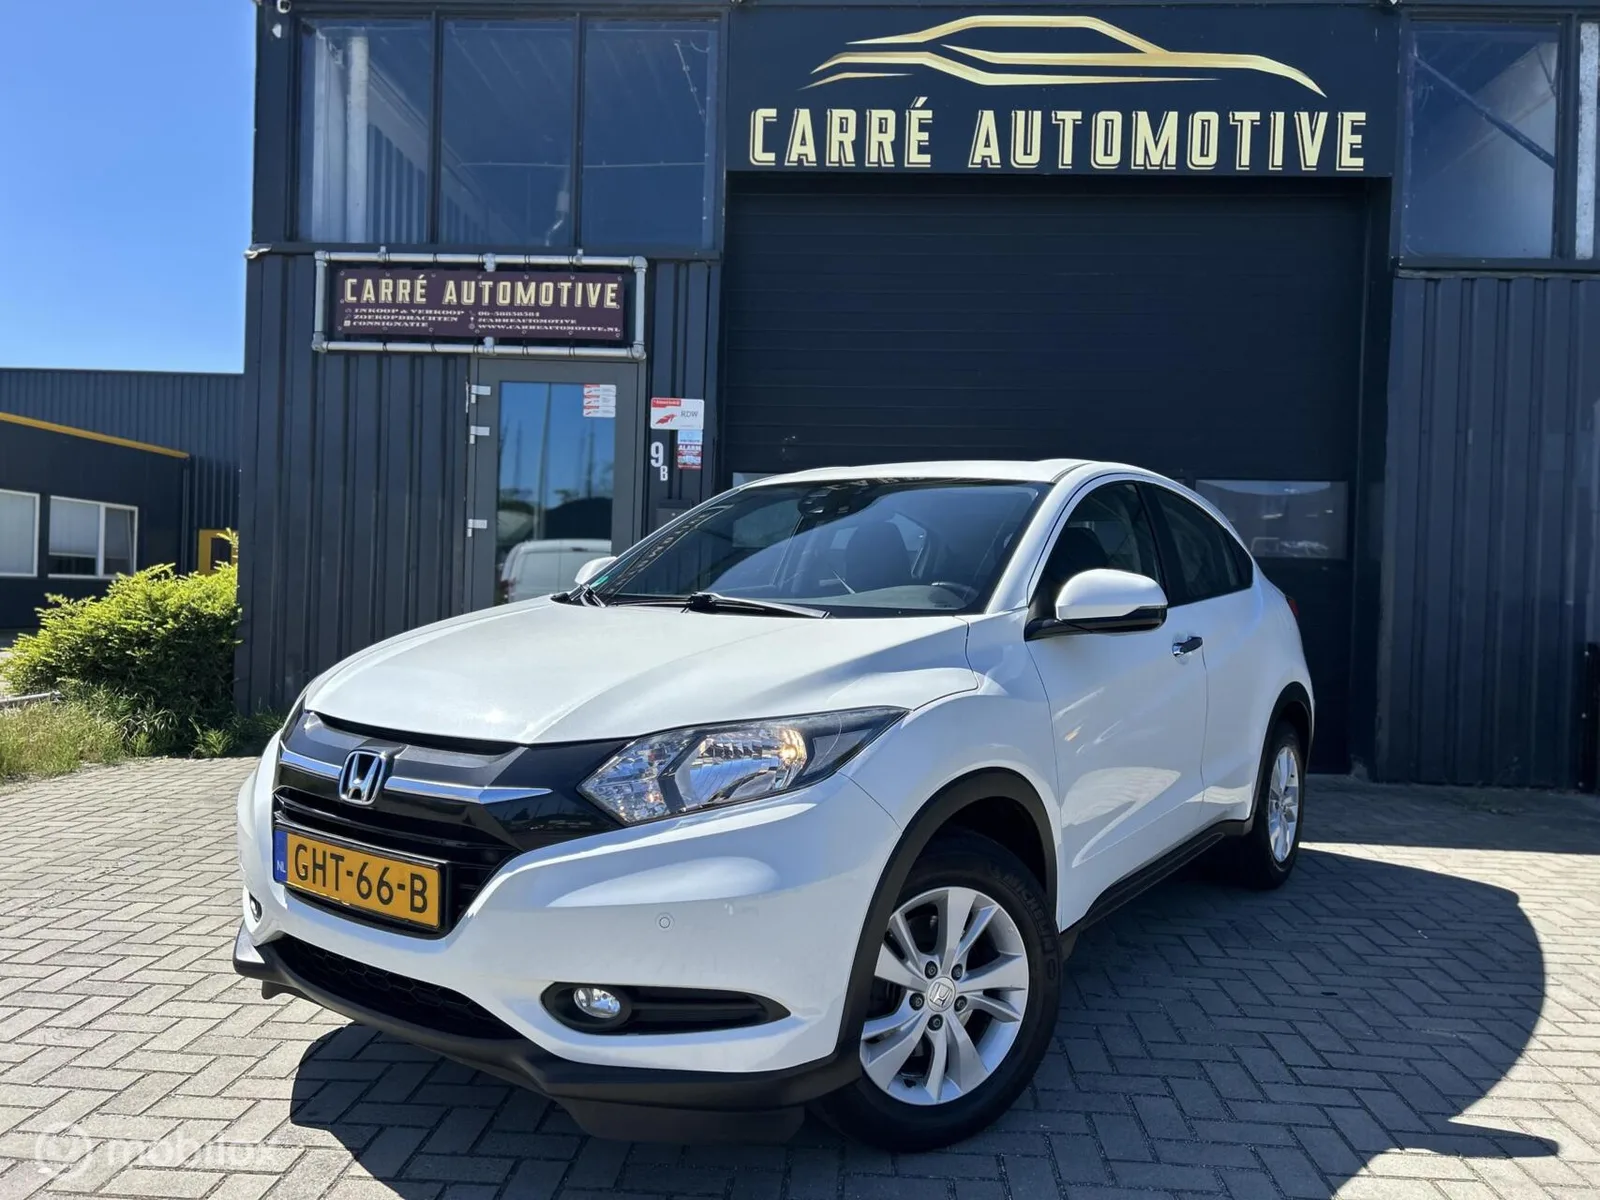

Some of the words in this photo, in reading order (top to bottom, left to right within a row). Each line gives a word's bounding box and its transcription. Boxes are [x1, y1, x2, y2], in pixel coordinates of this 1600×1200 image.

[750, 96, 933, 168] CARRÉ
[968, 109, 1367, 172] AUTOMOTIVE
[344, 275, 427, 304] CARRÉ
[442, 280, 619, 309] AUTOMOTIVE
[680, 410, 699, 418] RDW
[650, 441, 664, 468] 9
[660, 465, 668, 481] B
[276, 861, 287, 873] NL
[294, 843, 428, 914] GHT-66-B
